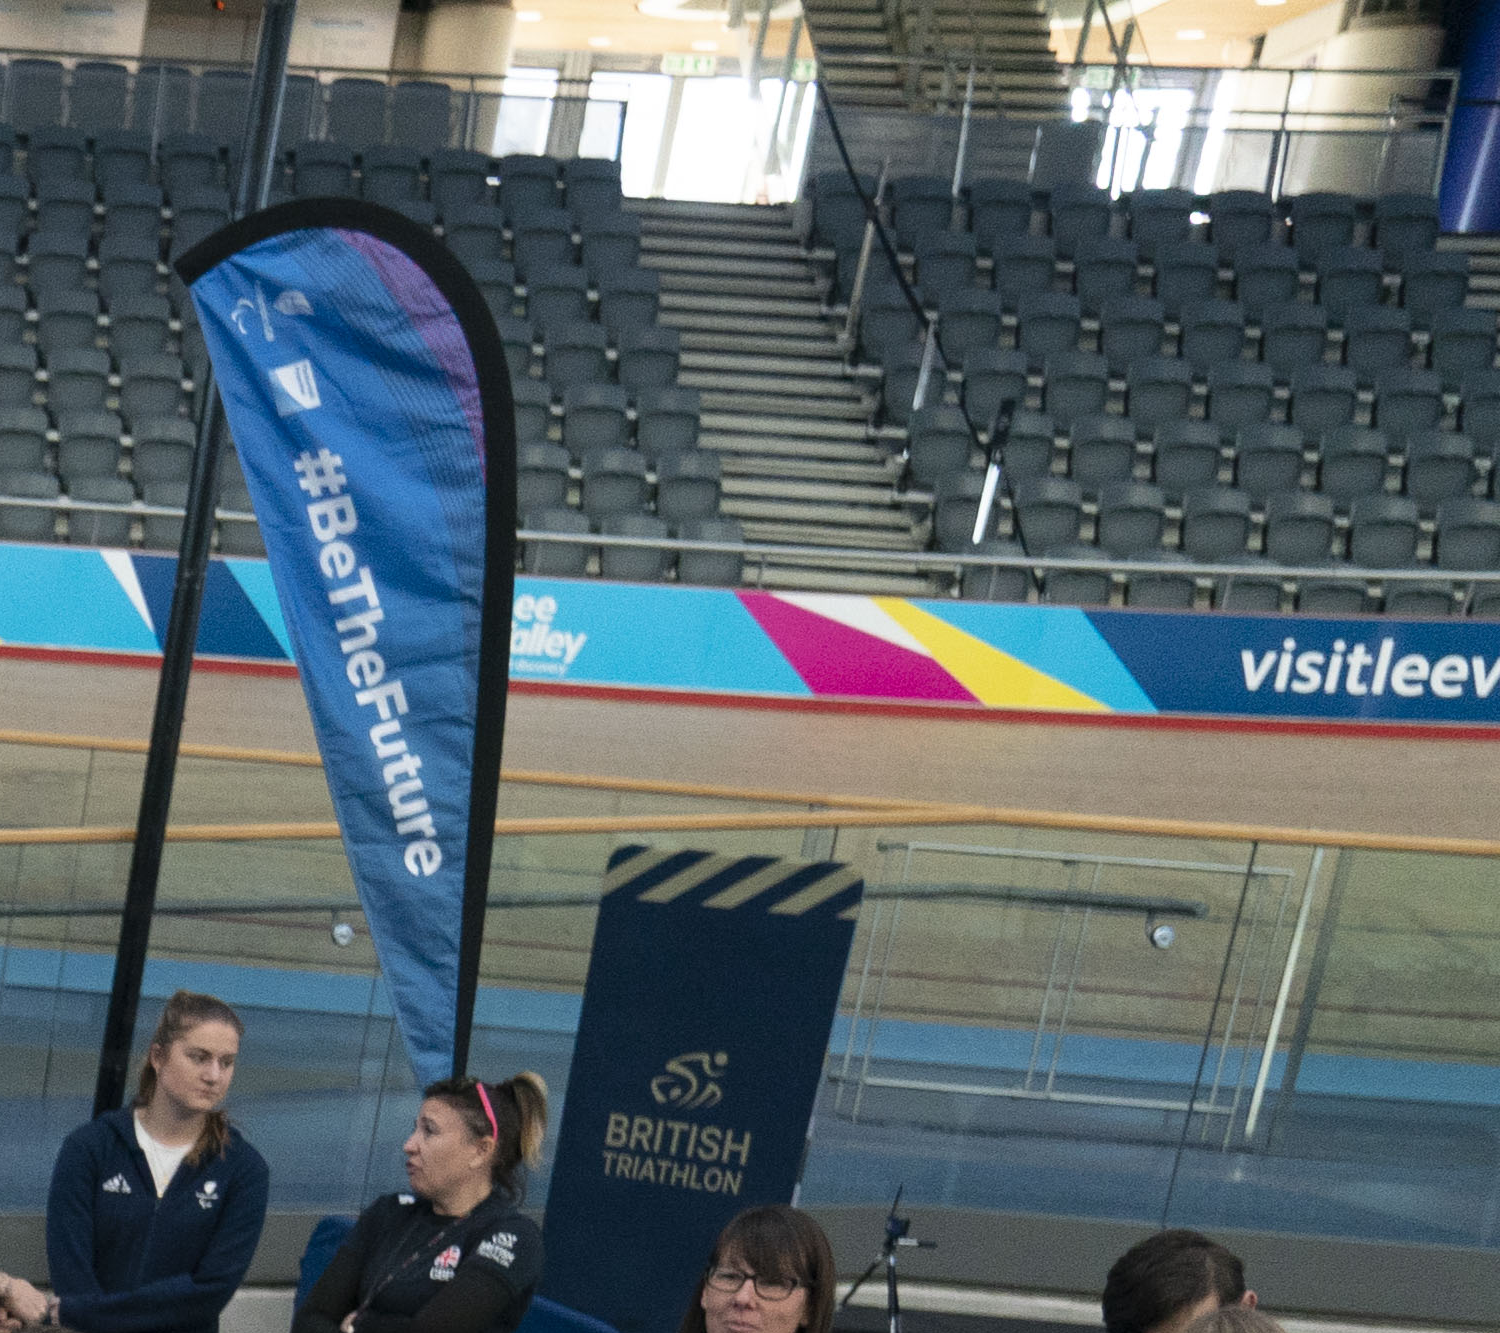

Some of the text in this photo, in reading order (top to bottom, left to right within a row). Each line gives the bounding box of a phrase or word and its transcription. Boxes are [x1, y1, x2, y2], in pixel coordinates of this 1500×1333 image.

[514, 594, 557, 622] ee
[294, 447, 442, 877] #BeTheFuture
[510, 622, 587, 664] alley
[605, 1112, 751, 1166] BRITISH
[603, 1150, 743, 1196] TRIATHLON
